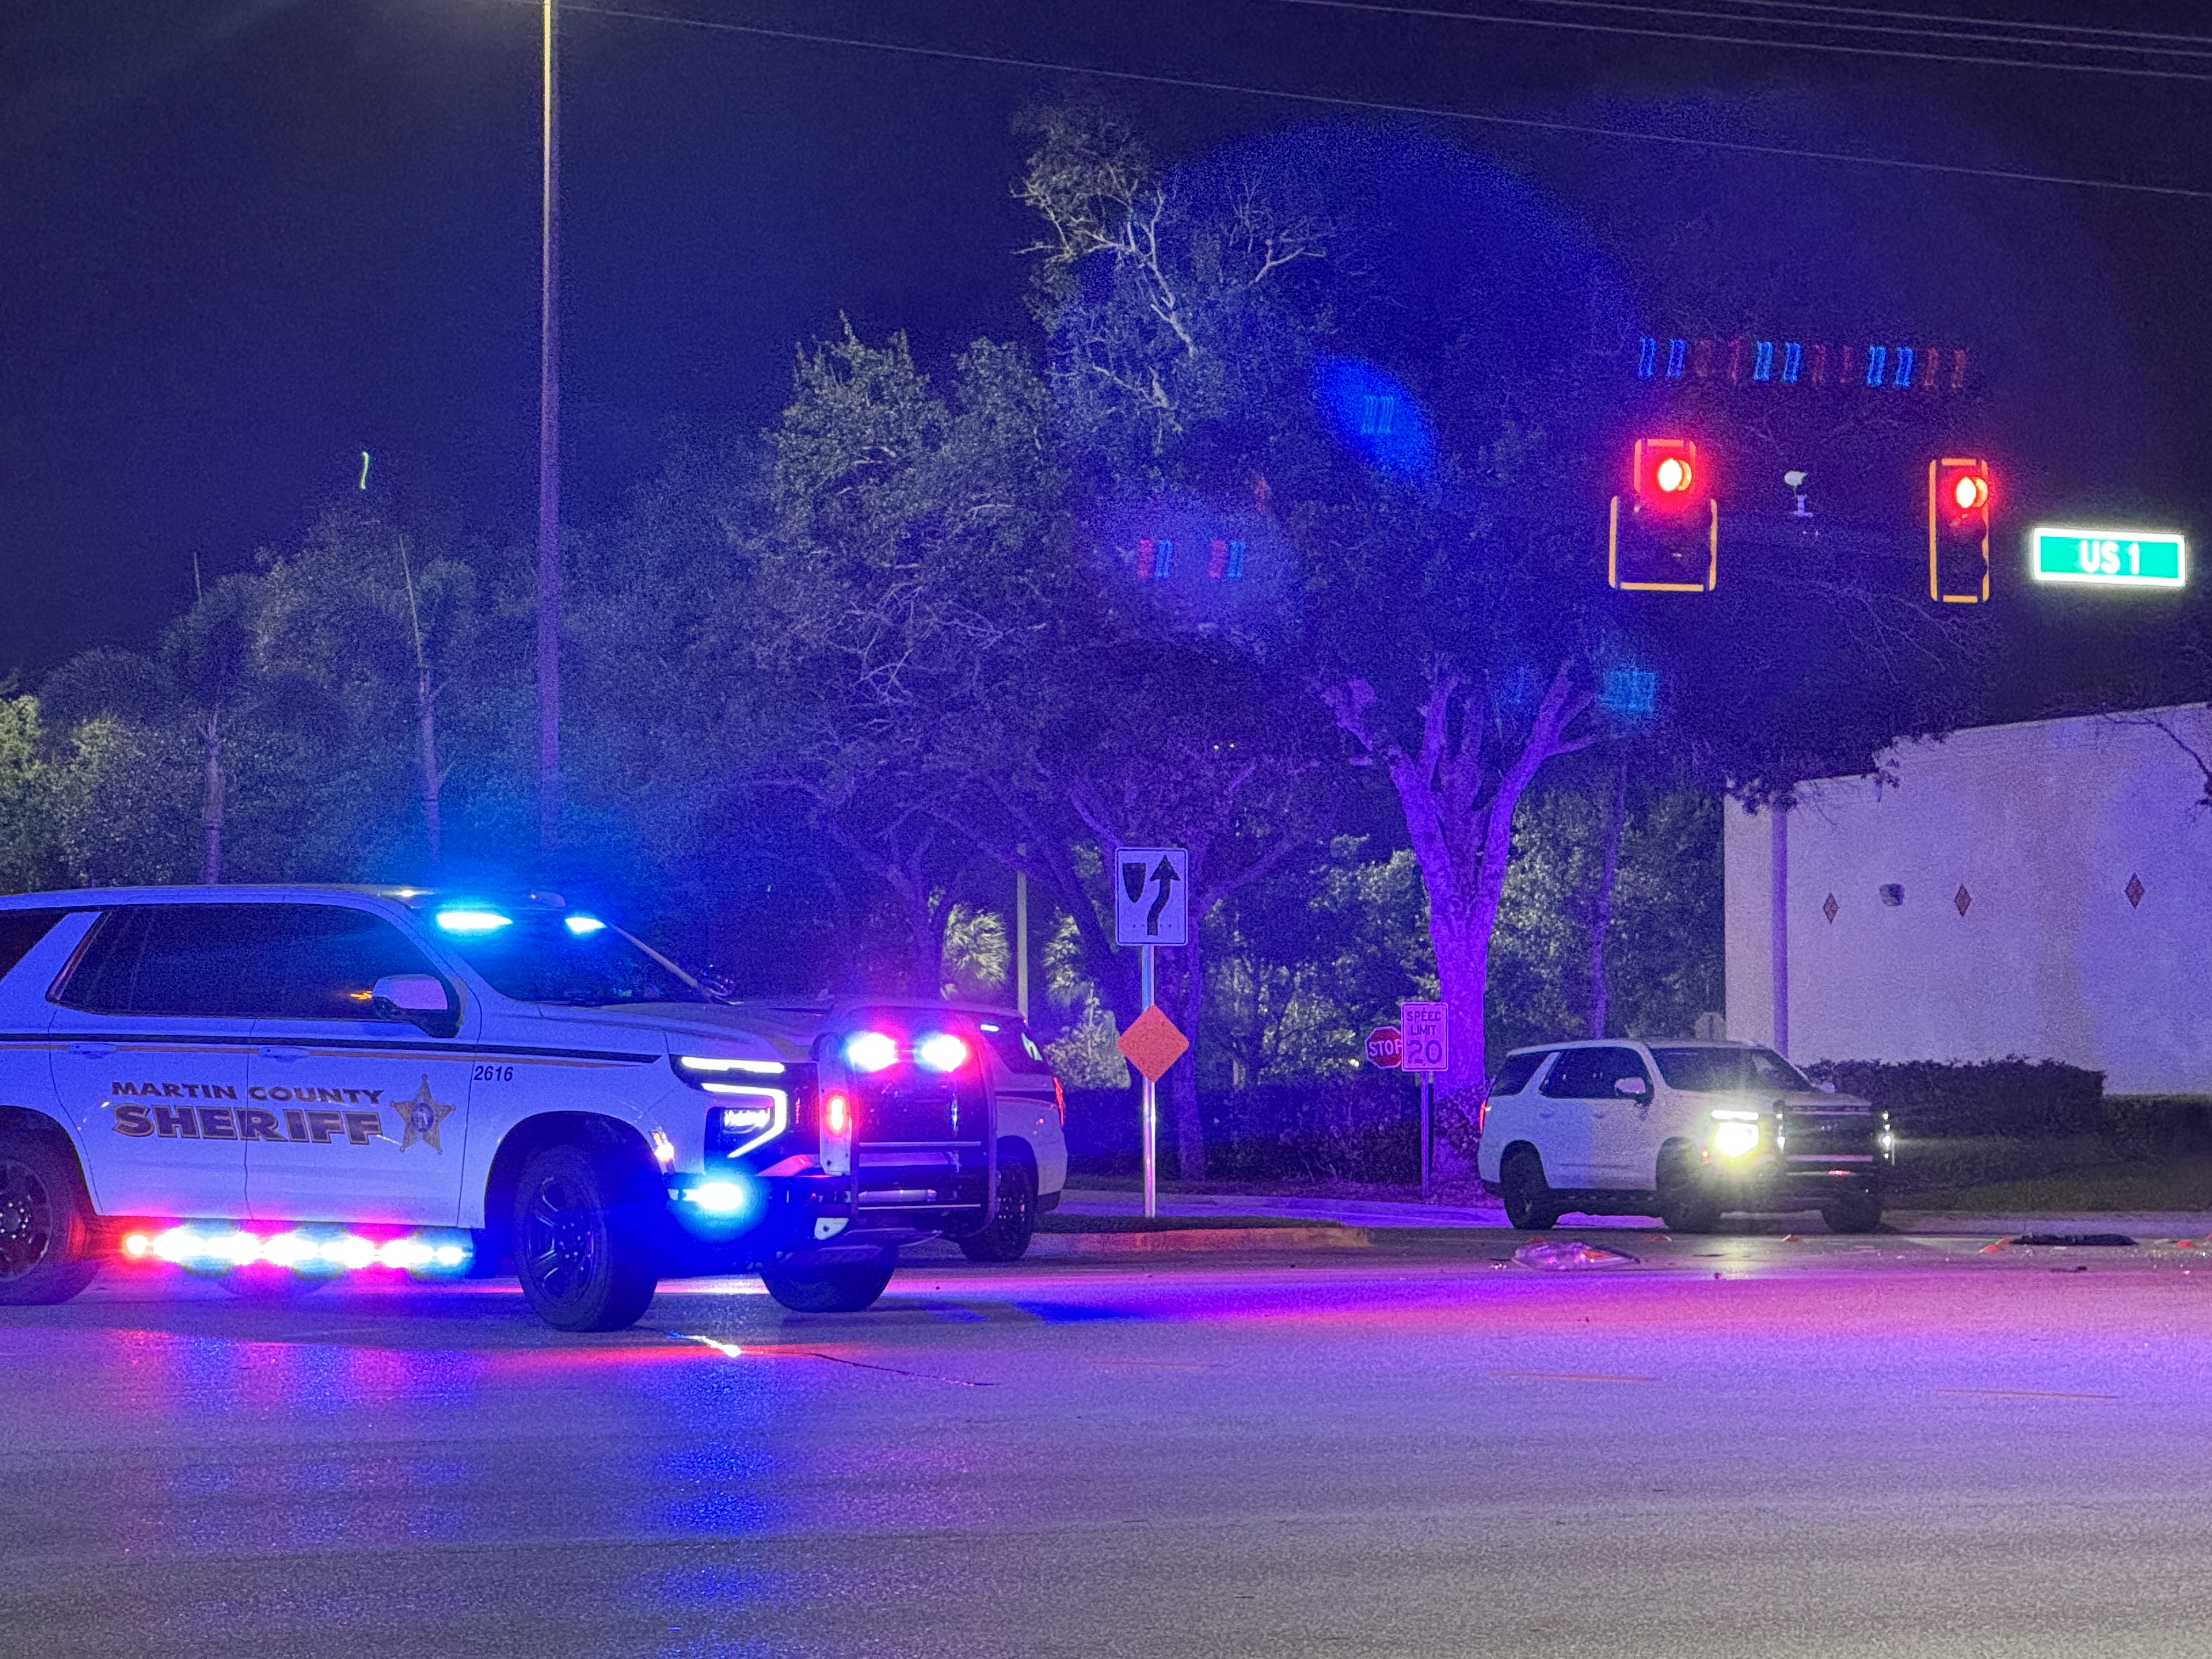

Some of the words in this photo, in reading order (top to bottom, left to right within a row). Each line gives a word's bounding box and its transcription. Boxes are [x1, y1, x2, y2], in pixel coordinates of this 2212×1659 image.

[2079, 540, 2119, 573] US
[2129, 543, 2140, 574] 1
[1410, 1025, 1437, 1036] LIMIT
[1407, 1040, 1443, 1064] 20
[474, 1066, 514, 1081] 2616
[111, 1081, 238, 1099] MARTIN
[249, 1086, 383, 1104] COUNTY
[112, 1103, 383, 1145] SHERIFF
